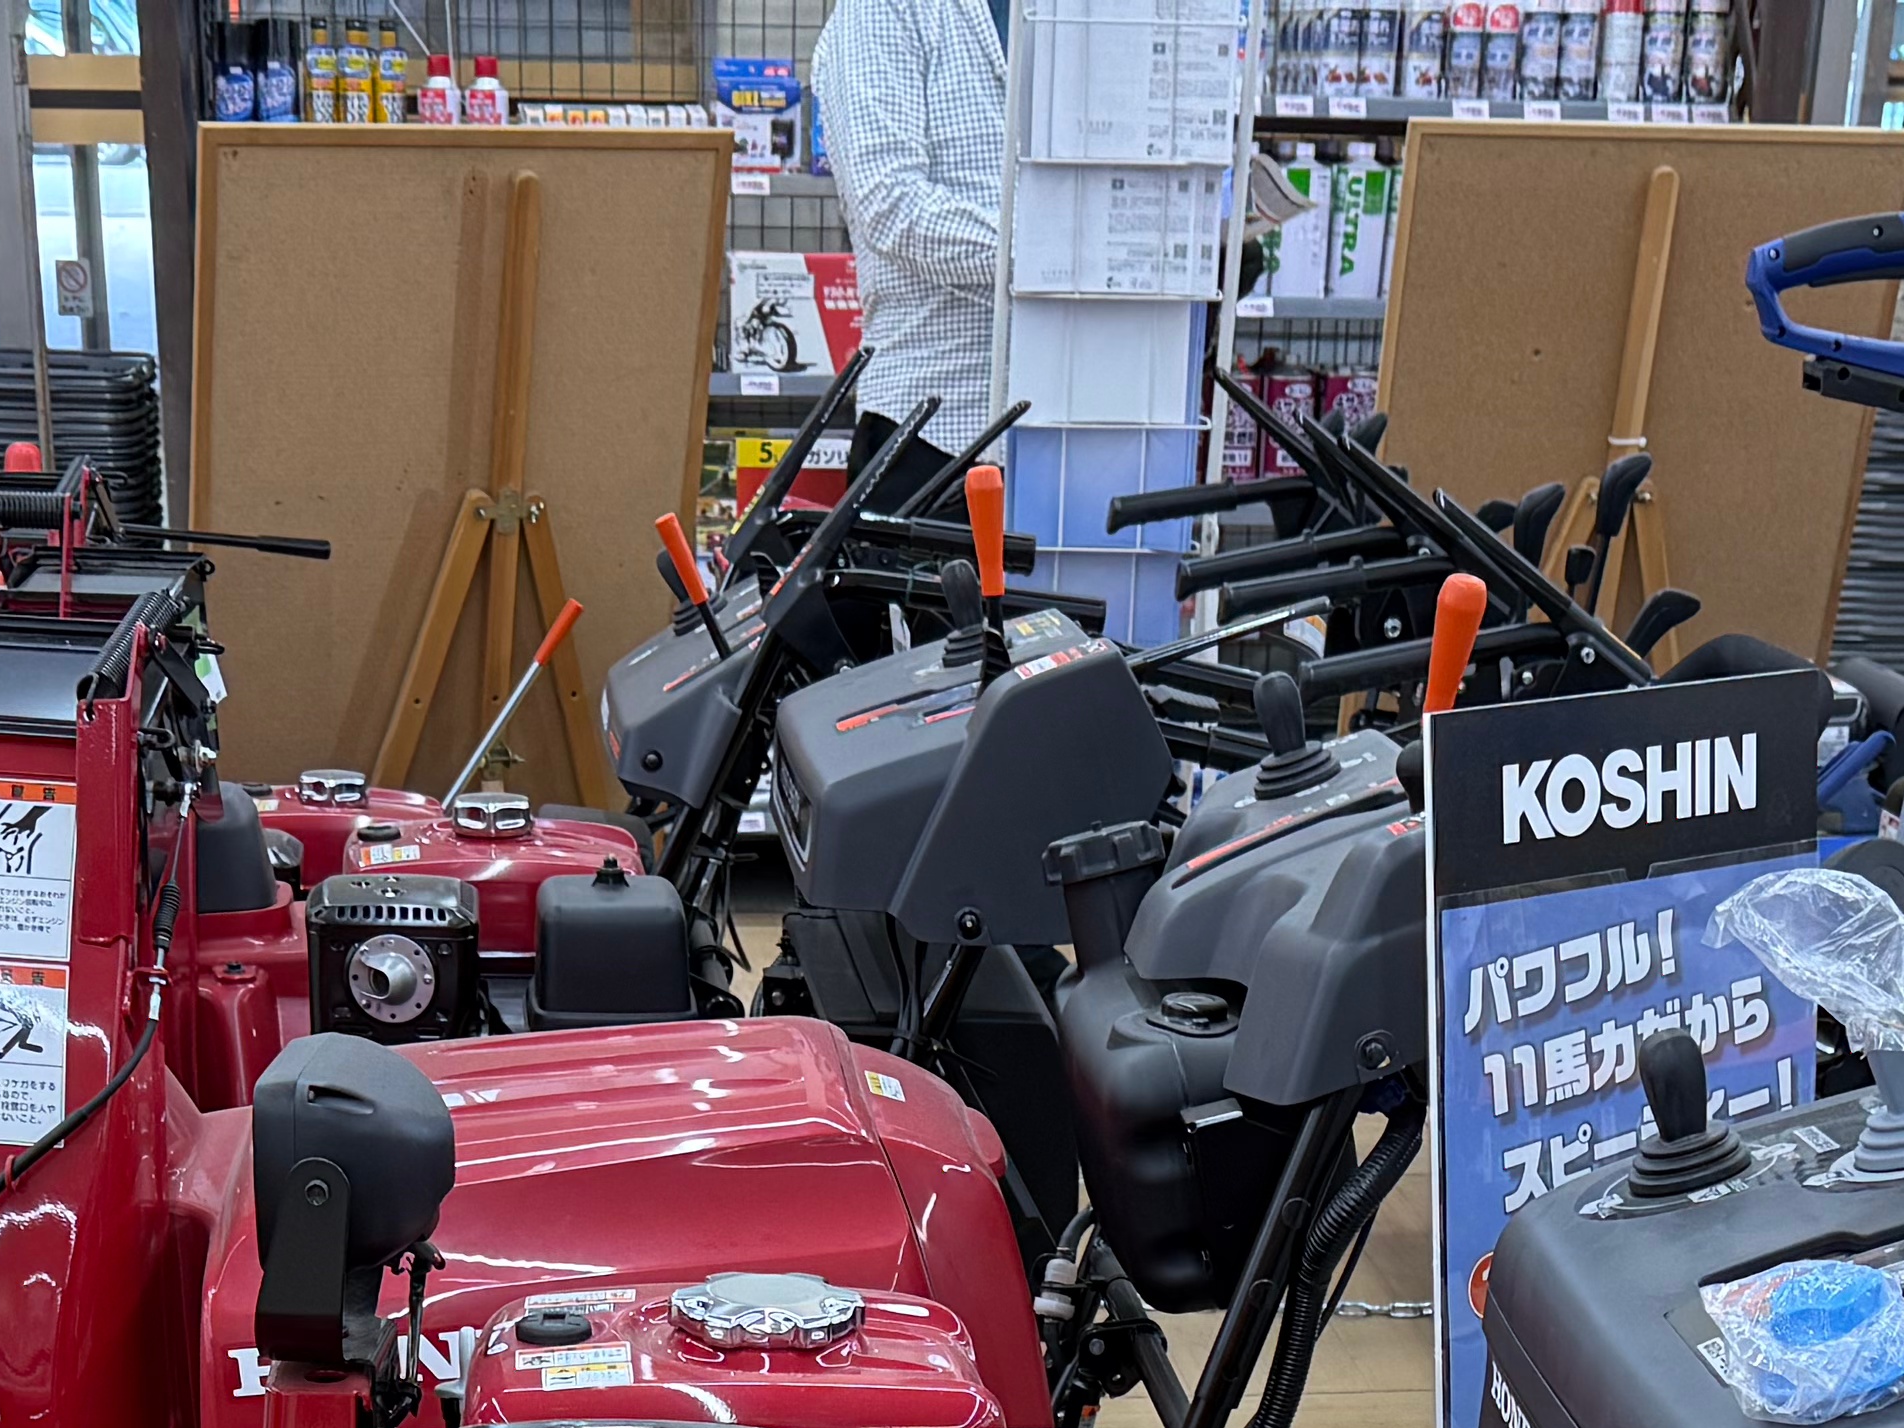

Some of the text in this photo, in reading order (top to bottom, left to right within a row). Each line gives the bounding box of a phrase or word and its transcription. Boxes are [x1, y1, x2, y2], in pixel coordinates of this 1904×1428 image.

[1502, 732, 1758, 845] KOSHIN
[1464, 909, 1676, 1034] パワフル！
[1503, 1057, 1793, 1213] スピーー！
